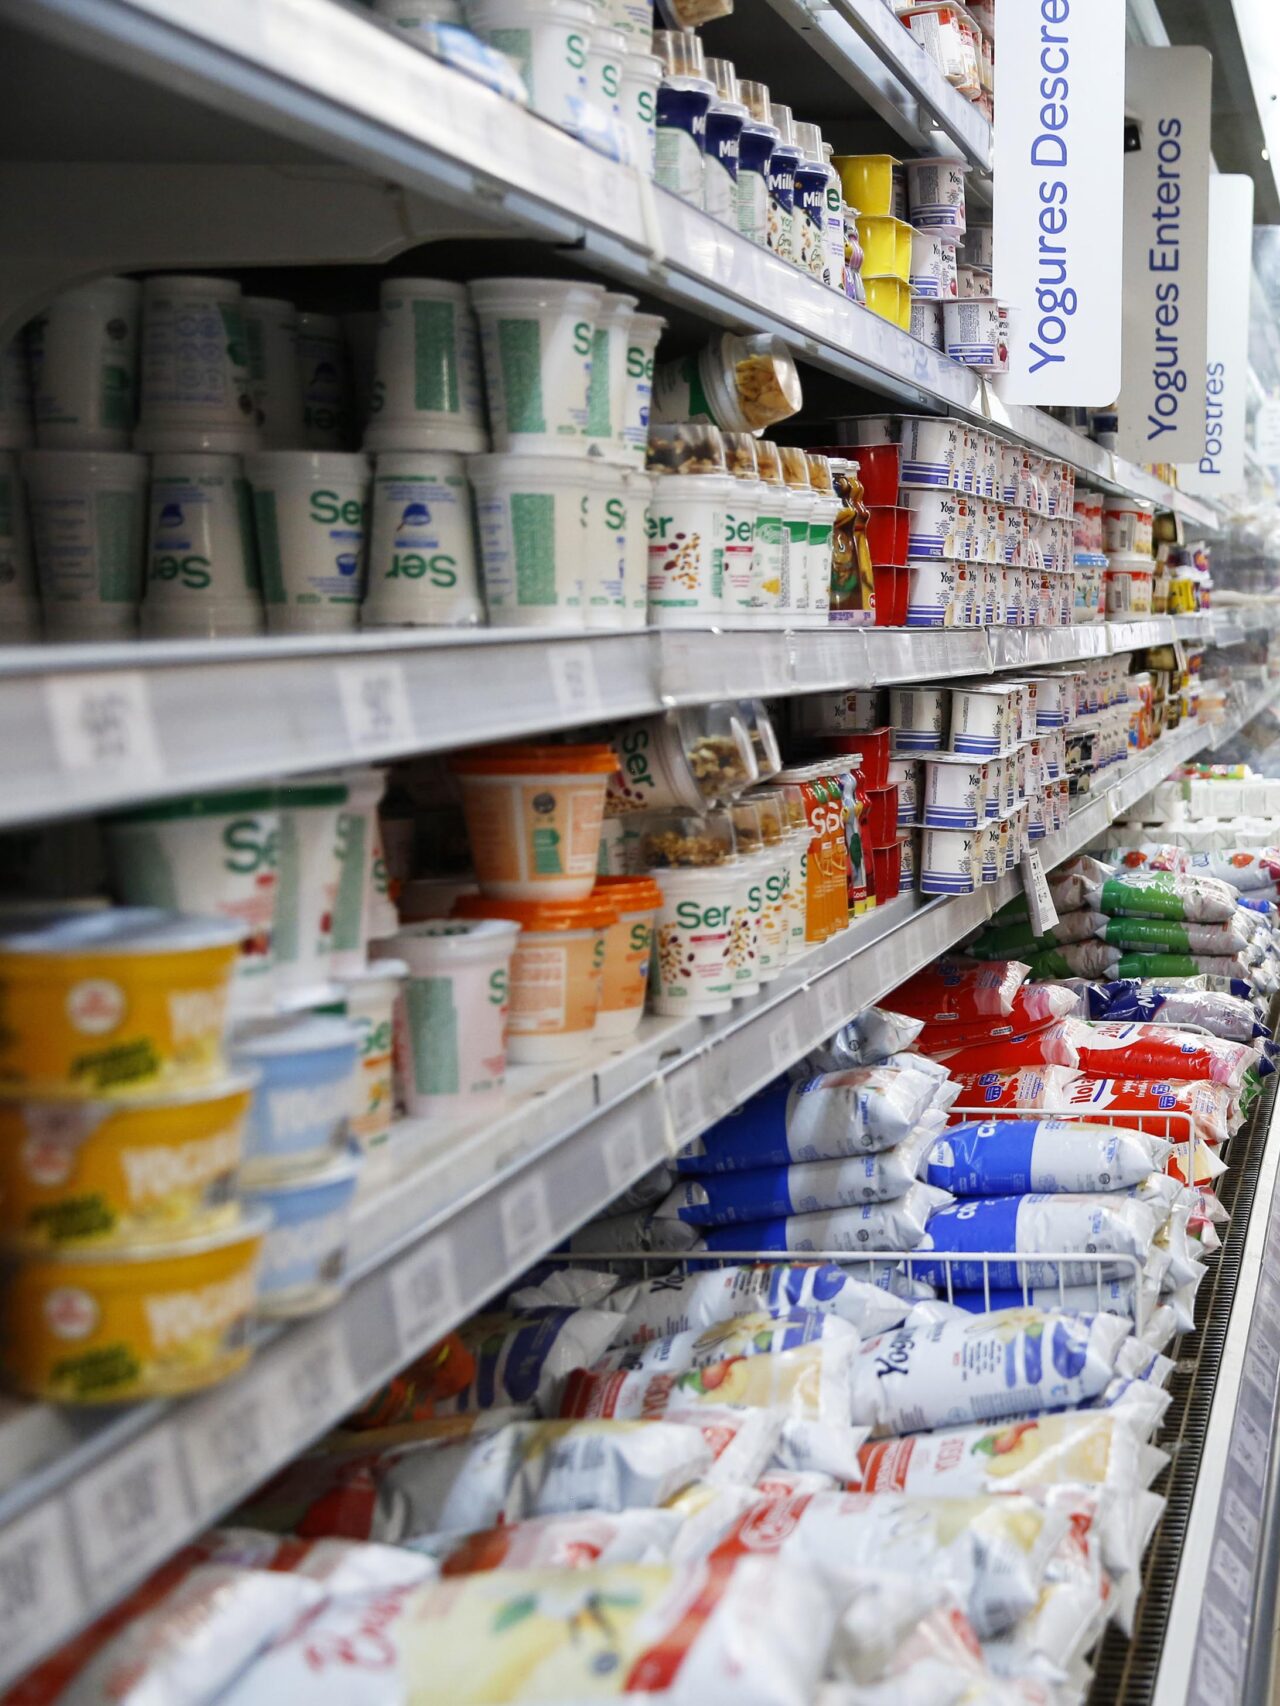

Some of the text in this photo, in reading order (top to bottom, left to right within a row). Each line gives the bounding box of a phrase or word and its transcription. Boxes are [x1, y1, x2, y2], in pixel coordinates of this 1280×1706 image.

[1028, 180, 1078, 374] Yogures
[1147, 117, 1188, 442] Yogures Enteros
[1198, 361, 1225, 476] Postres
[384, 553, 458, 589] Ser
[622, 728, 656, 788] Ser
[675, 900, 732, 931] Ser
